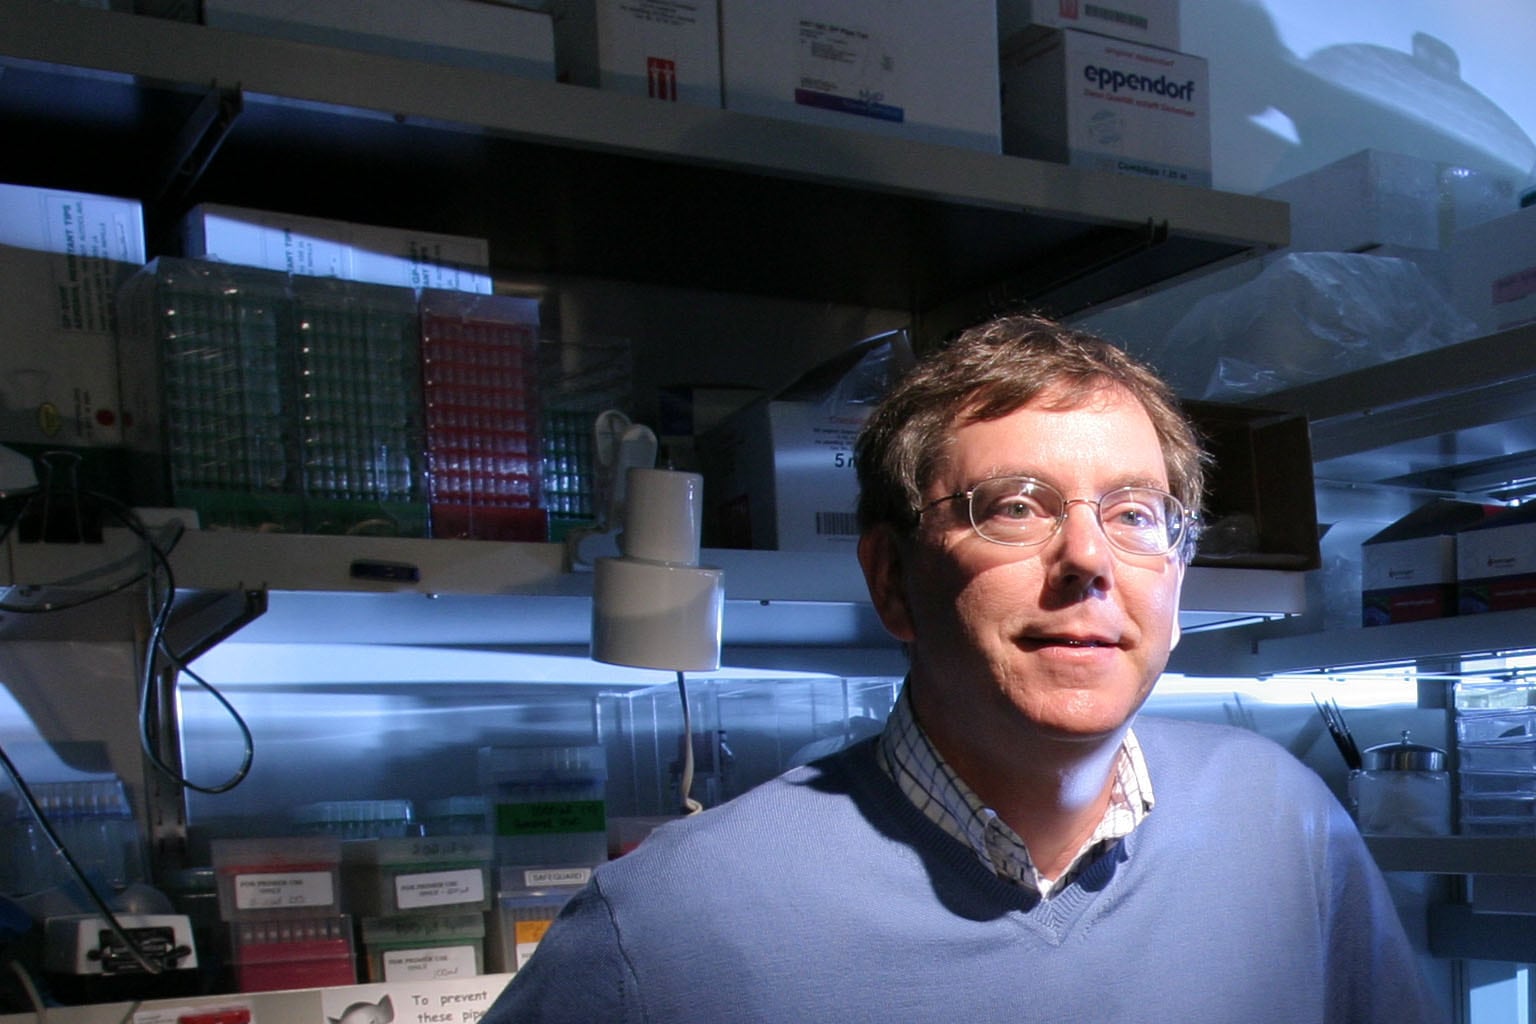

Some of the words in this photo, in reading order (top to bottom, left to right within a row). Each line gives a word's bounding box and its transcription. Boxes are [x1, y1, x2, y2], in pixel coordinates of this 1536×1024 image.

[1084, 64, 1195, 102] eppendorf
[834, 452, 845, 468] 5
[532, 871, 583, 882] SAFEGUARD
[411, 995, 429, 1006] To
[440, 991, 488, 1006] prevent
[417, 1012, 453, 1023] these
